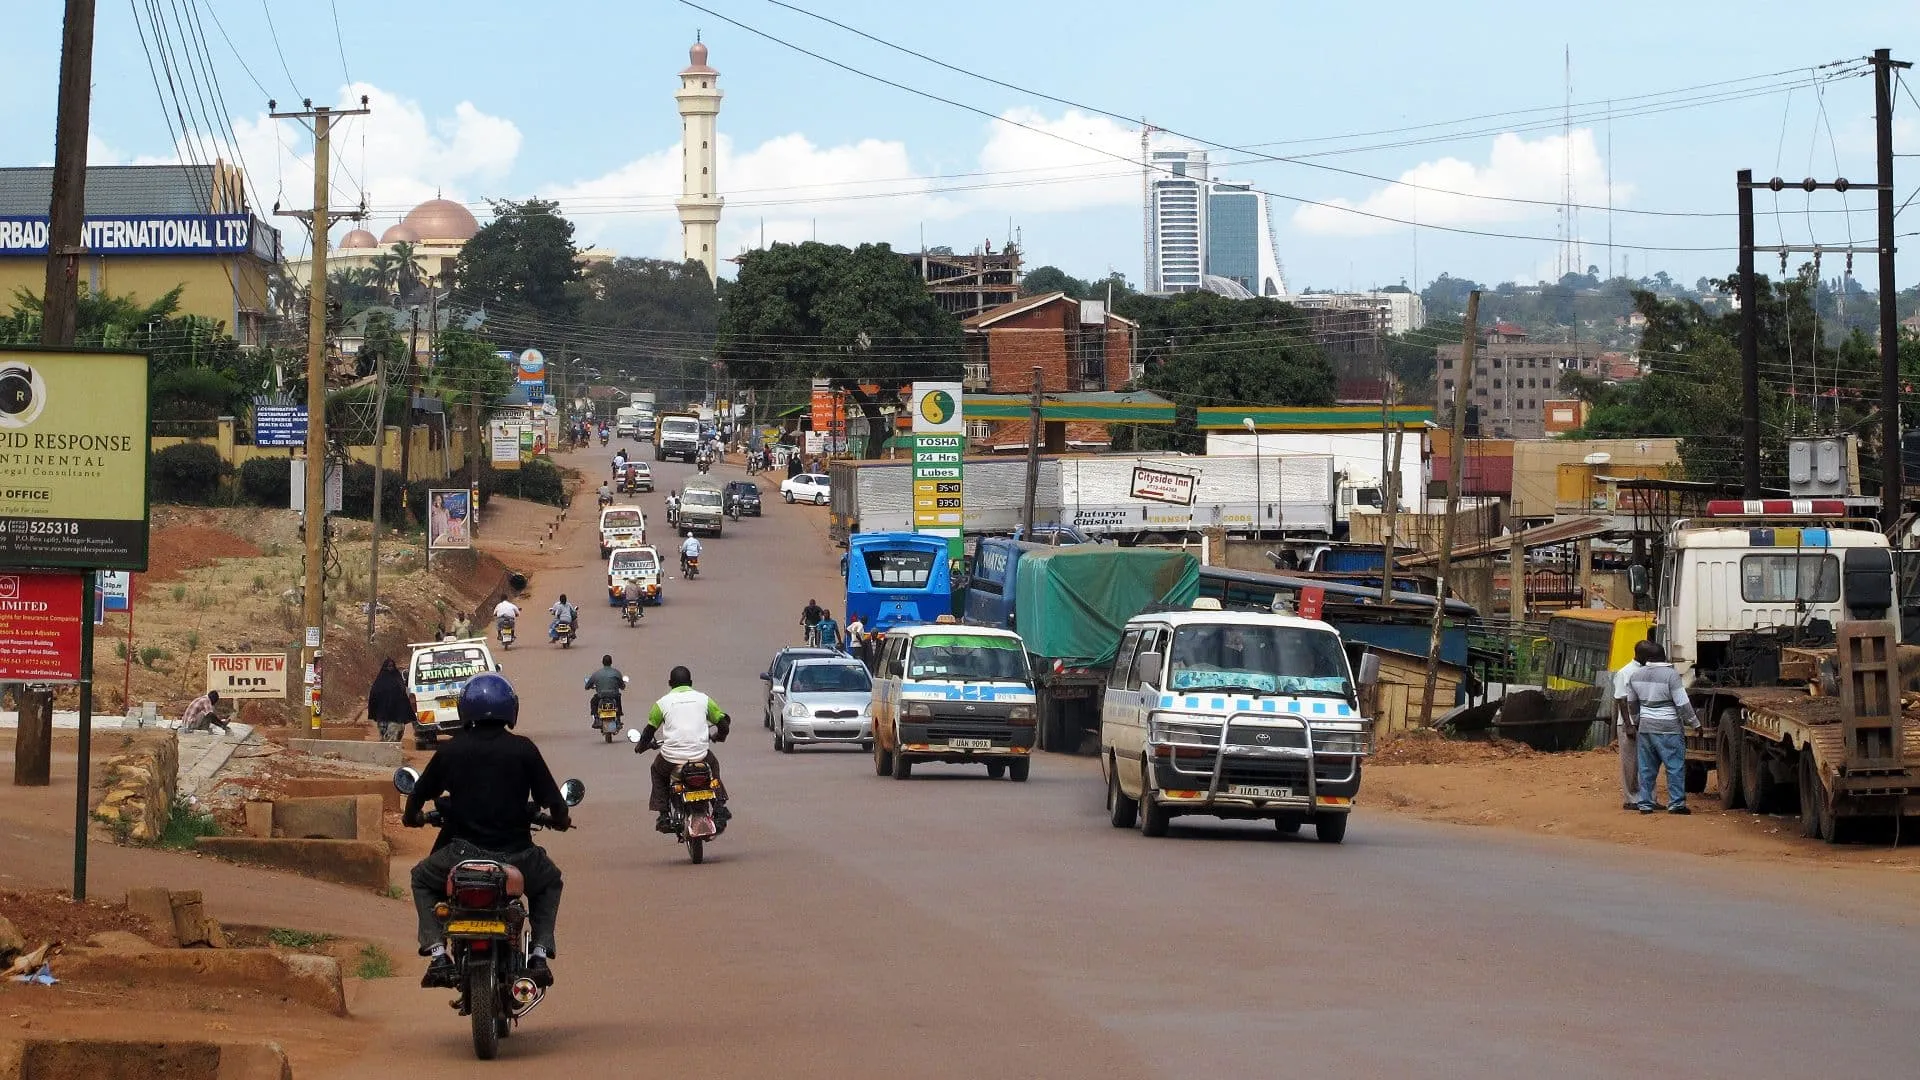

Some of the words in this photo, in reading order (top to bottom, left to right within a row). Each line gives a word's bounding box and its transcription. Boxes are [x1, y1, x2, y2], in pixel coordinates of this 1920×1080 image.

[0, 222, 51, 248] RBAD
[79, 221, 211, 248] NTERNATIONAL
[216, 220, 248, 247] LTD
[34, 433, 131, 451] RESPONSE
[919, 438, 957, 446] TOSHA
[920, 454, 933, 462] 24
[938, 454, 957, 462] Hrs
[33, 468, 101, 477] Consultants
[921, 469, 954, 477] Lubes
[1138, 471, 1173, 485] Cityside
[1175, 476, 1189, 488] Inn
[6, 489, 49, 500] OFFICE
[30, 522, 79, 534] 525318
[0, 601, 48, 611] IMITED
[211, 658, 251, 671] TRUST
[254, 657, 285, 671] VIEW
[228, 676, 267, 686] Inn
